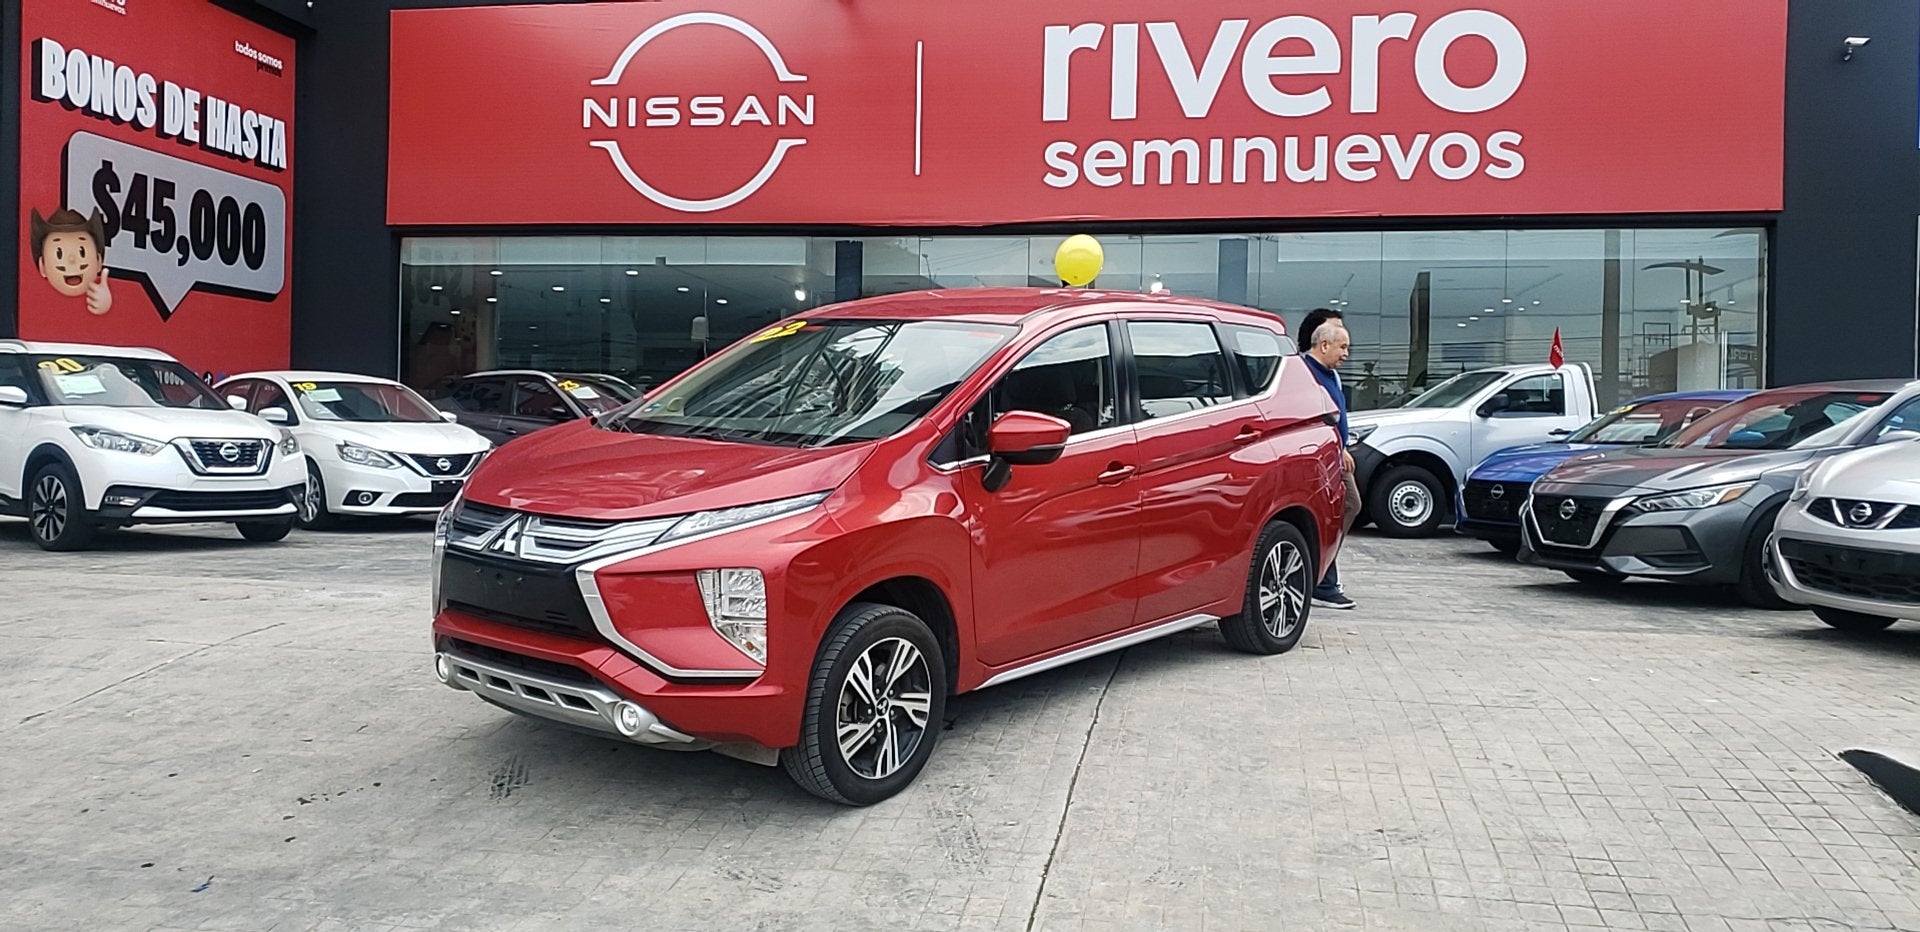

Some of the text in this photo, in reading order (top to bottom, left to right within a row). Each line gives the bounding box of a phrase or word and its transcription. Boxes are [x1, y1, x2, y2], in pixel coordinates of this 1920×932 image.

[235, 40, 282, 70] todos somos
[1042, 9, 1527, 121] rivero
[41, 37, 287, 169] BONOS DE HASTA
[583, 95, 814, 128] NISSAN
[1043, 131, 1525, 187] seminuevos
[92, 160, 266, 271] $45,000
[292, 382, 317, 391] 19
